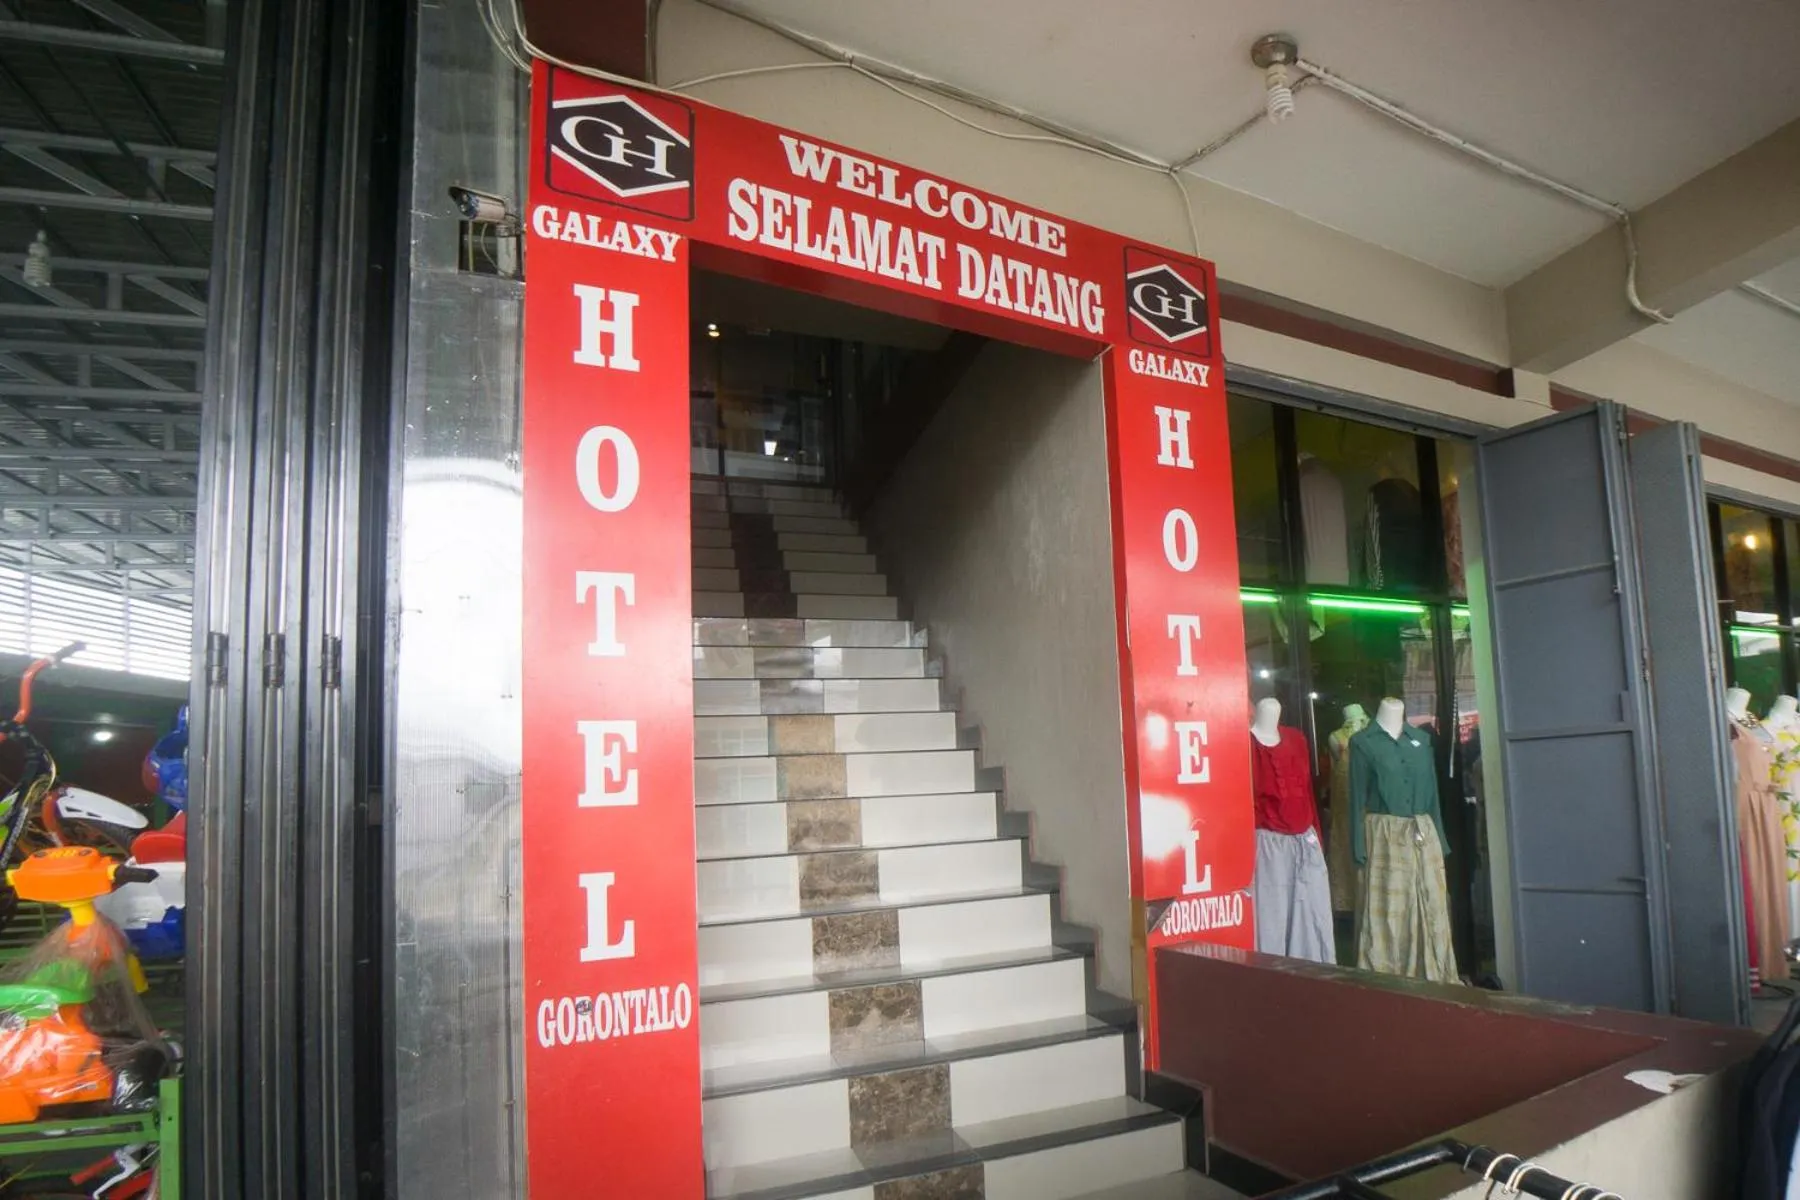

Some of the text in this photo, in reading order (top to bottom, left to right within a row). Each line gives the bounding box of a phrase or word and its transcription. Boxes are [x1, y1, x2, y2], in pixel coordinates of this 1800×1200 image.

[532, 204, 680, 263] GALAXY
[727, 178, 1105, 335] SELAMAT DATANG
[779, 134, 1067, 257] WELCOME
[1128, 349, 1210, 388] GALAXY
[573, 284, 641, 962] HOTEL
[1154, 405, 1212, 895] HOTEL
[537, 982, 692, 1049] GORONTALO
